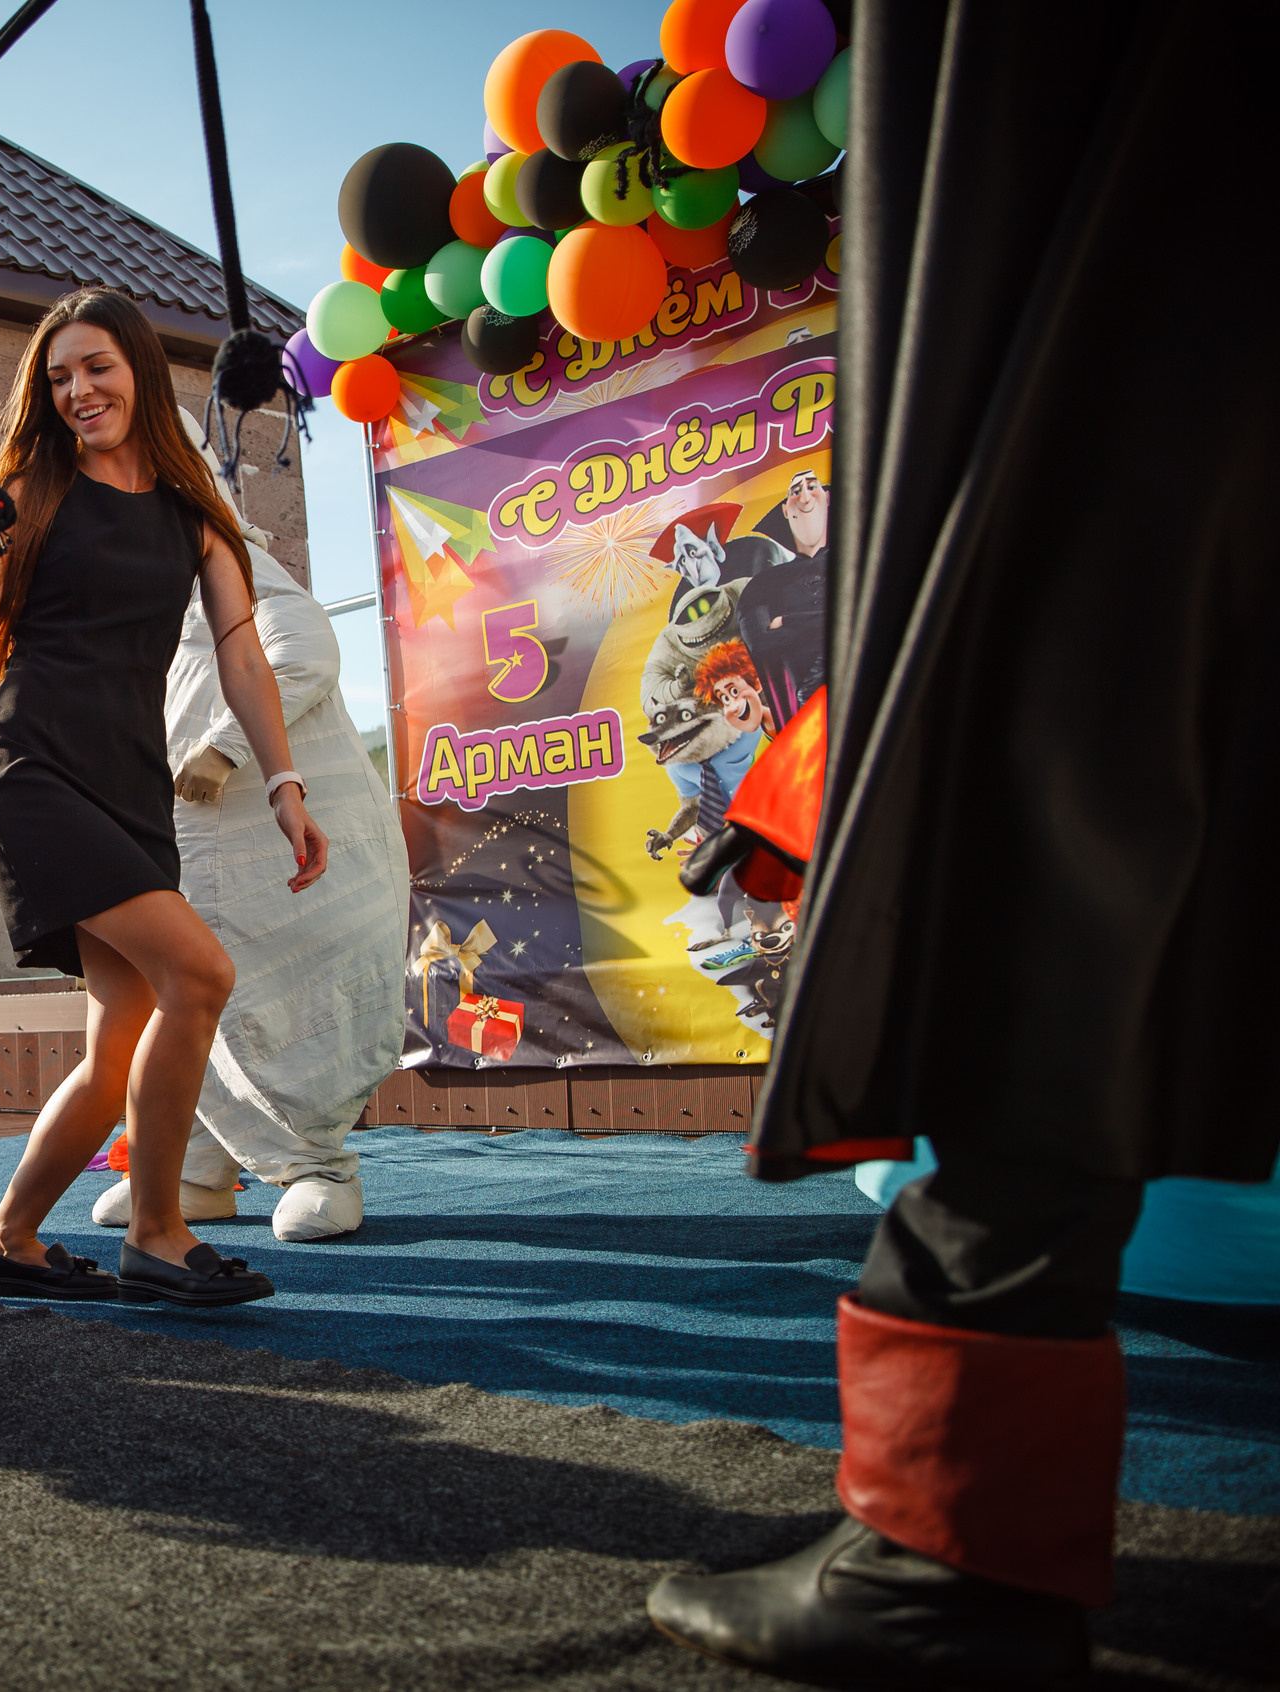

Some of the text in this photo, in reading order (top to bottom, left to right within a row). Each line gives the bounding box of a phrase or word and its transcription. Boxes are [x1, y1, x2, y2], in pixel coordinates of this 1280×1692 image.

[498, 479, 561, 537] С
[568, 409, 757, 514] Днём
[481, 598, 549, 704] 5
[426, 720, 615, 799] Арман
